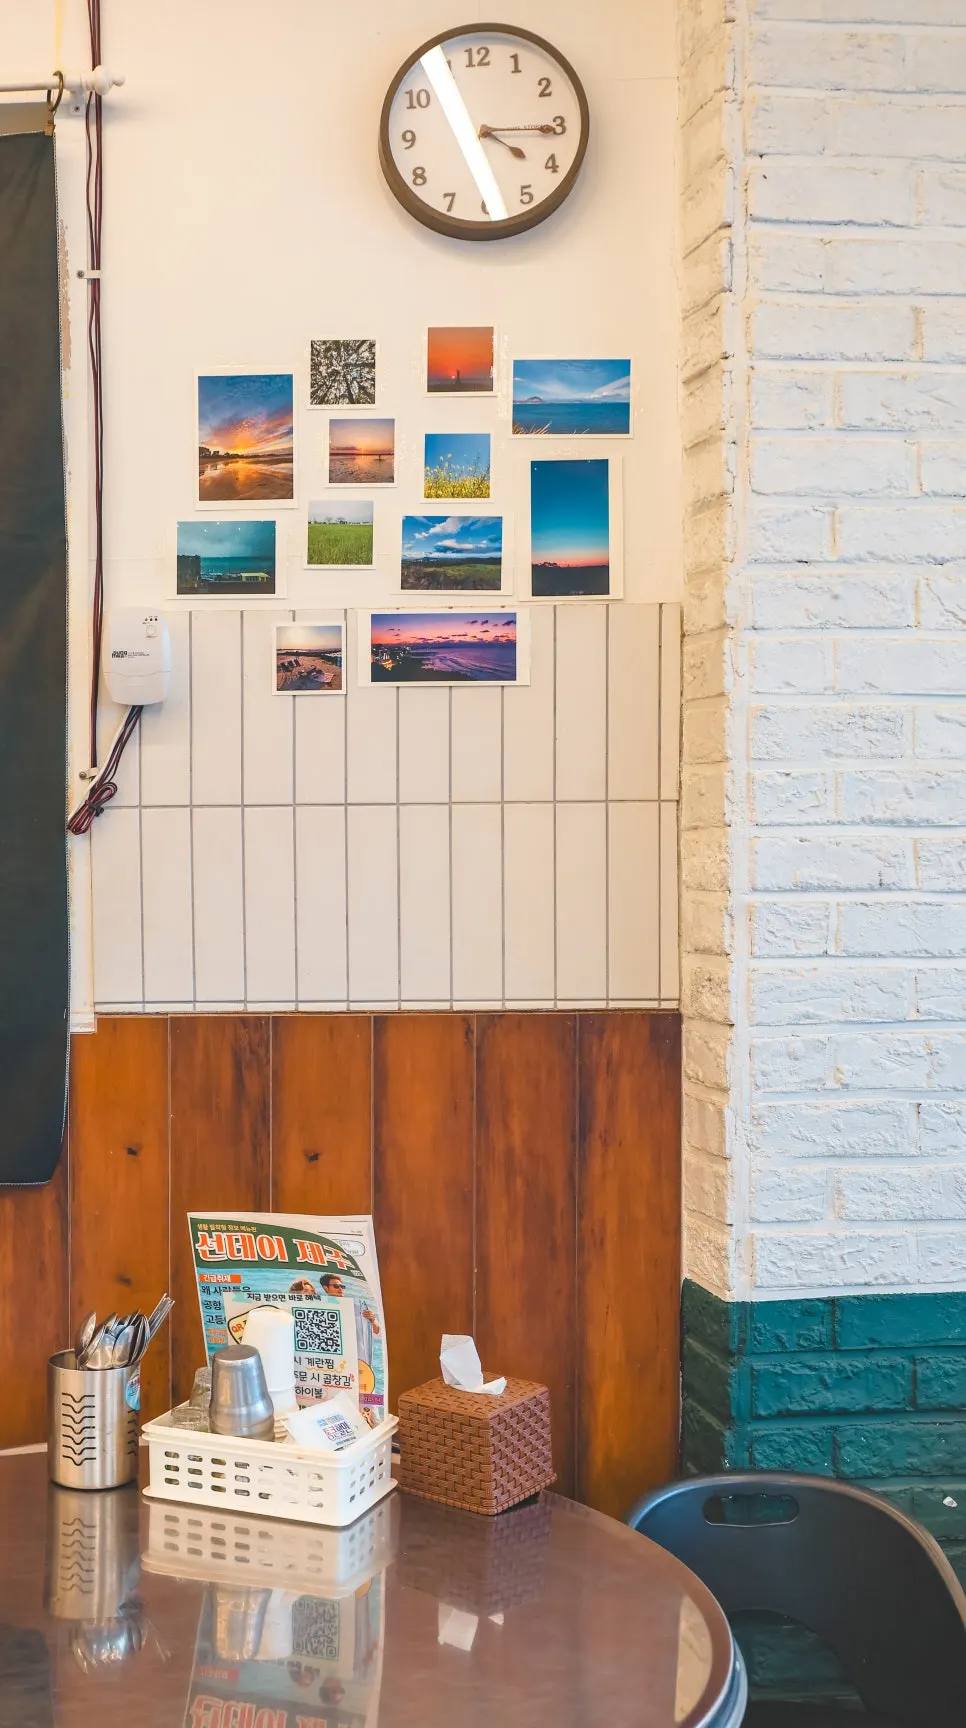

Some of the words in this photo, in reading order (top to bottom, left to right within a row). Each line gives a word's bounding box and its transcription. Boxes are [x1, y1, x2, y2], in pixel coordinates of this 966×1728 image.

[464, 46, 491, 68] 12
[509, 53, 522, 74] 1
[537, 77, 553, 98] 2
[404, 88, 431, 110] 10
[552, 115, 567, 136] 3
[401, 129, 417, 150] 9
[544, 153, 559, 174] 4
[412, 166, 427, 186] 8
[443, 192, 456, 212] 7
[519, 184, 534, 204] 5
[195, 1231, 289, 1262] 선데이
[292, 1238, 355, 1270] 제주
[203, 1274, 232, 1283] 긴급취재
[201, 1285, 211, 1296] 왜
[247, 1293, 261, 1302] 지금
[263, 1293, 286, 1302] 받으면
[288, 1294, 303, 1302] 바로
[204, 1300, 222, 1311] 공항
[206, 1314, 226, 1325] 고등
[231, 1323, 244, 1334] QR
[304, 1357, 334, 1370] 계란찜
[310, 1373, 320, 1382] 시
[322, 1373, 351, 1387] 곱창김
